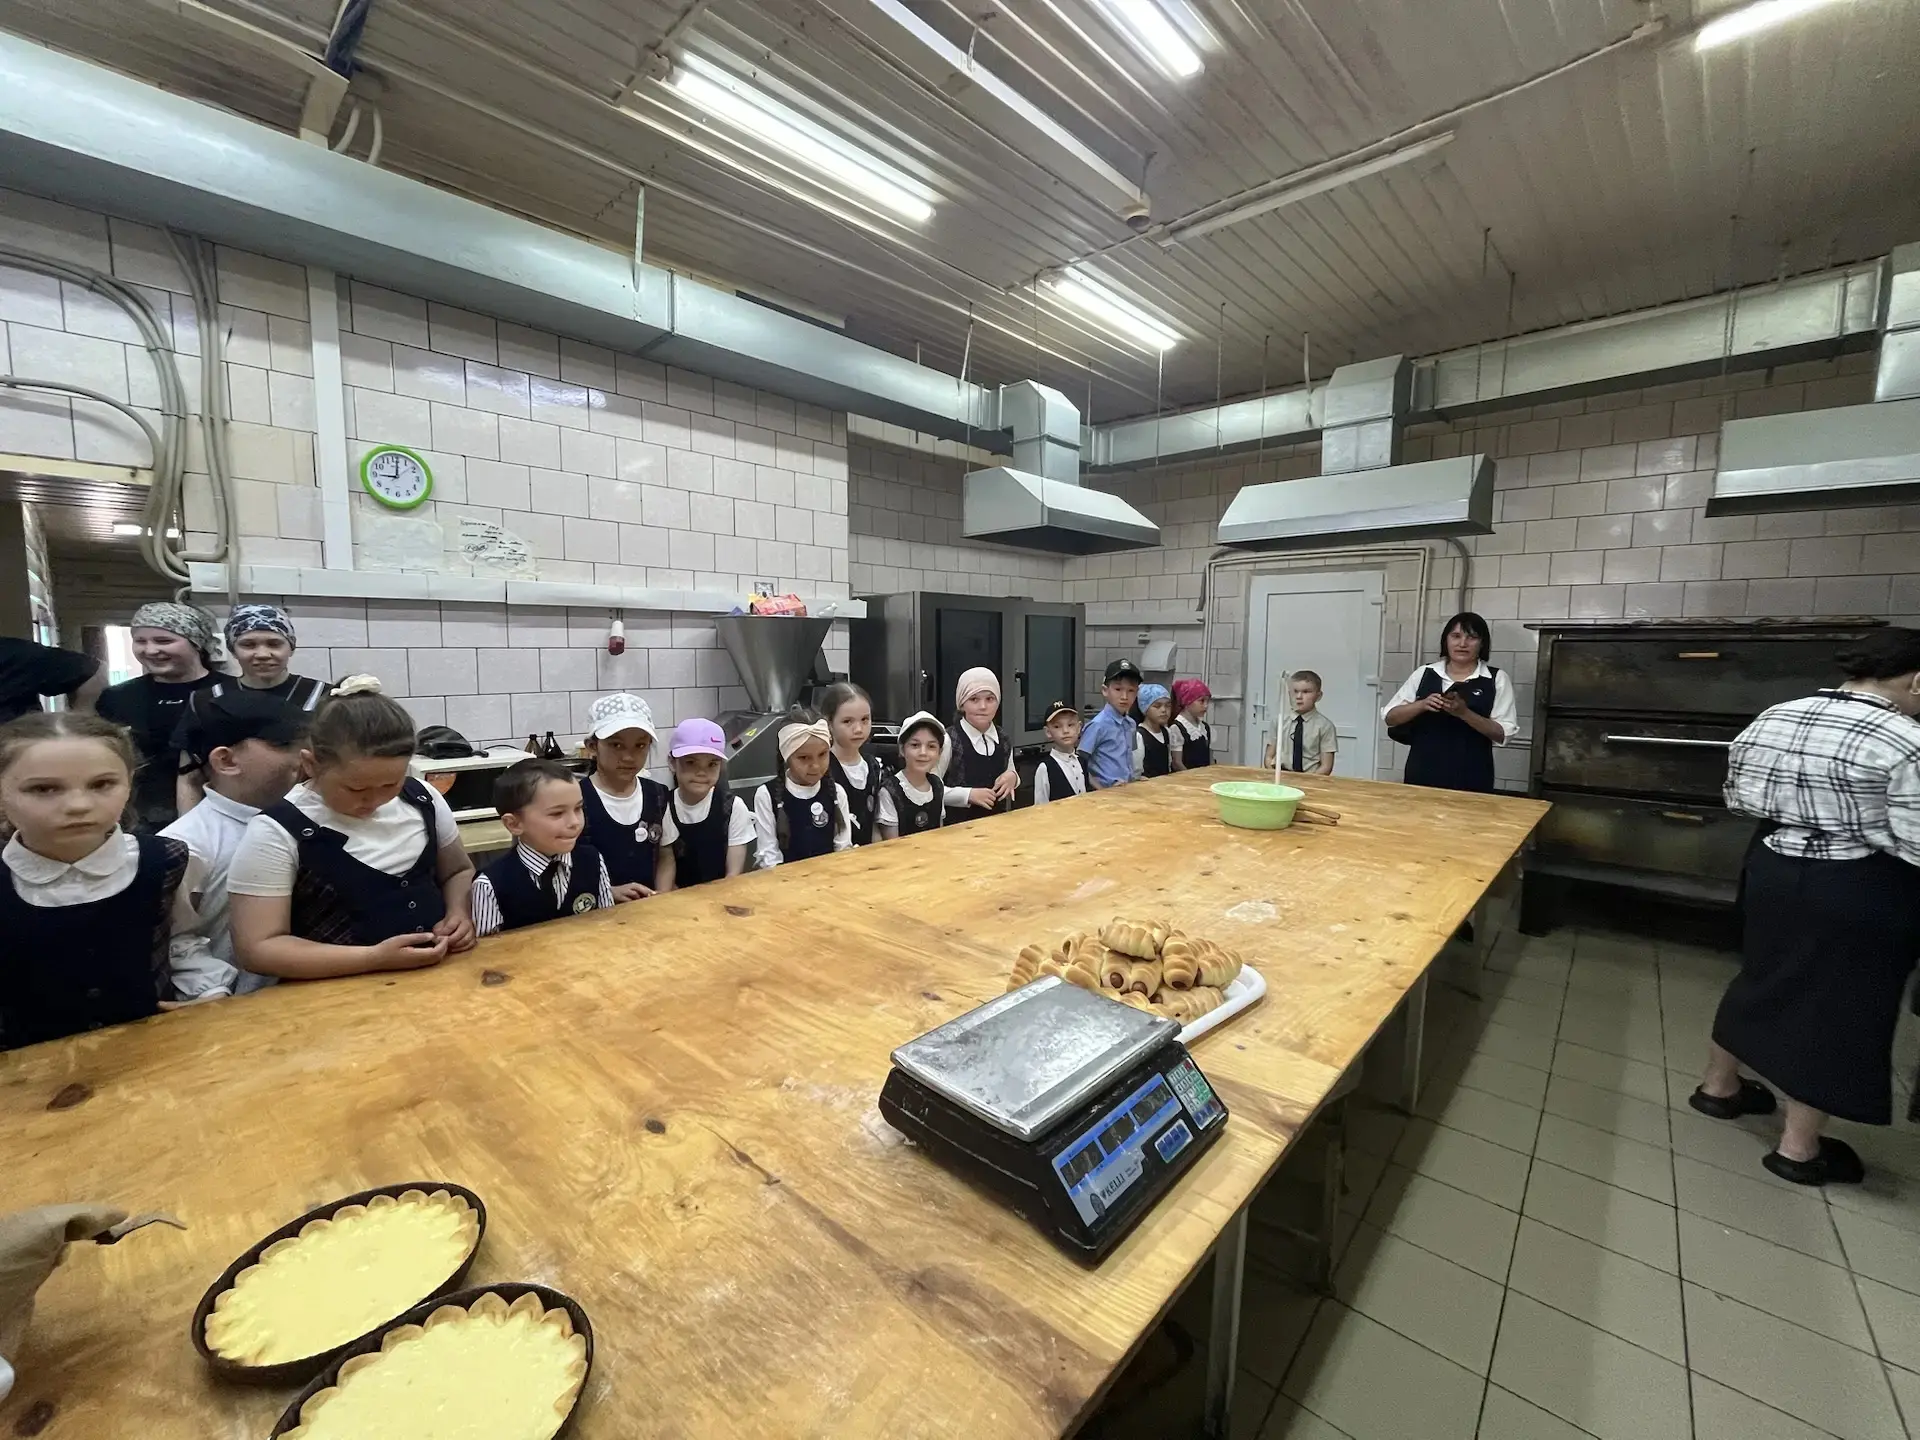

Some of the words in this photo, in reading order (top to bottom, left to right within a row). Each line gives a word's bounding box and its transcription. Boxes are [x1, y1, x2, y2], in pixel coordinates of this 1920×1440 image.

[381, 456, 390, 465] 11
[374, 463, 384, 471] 10
[411, 466, 416, 474] 2
[376, 480, 382, 488] 8
[384, 487, 390, 495] 7
